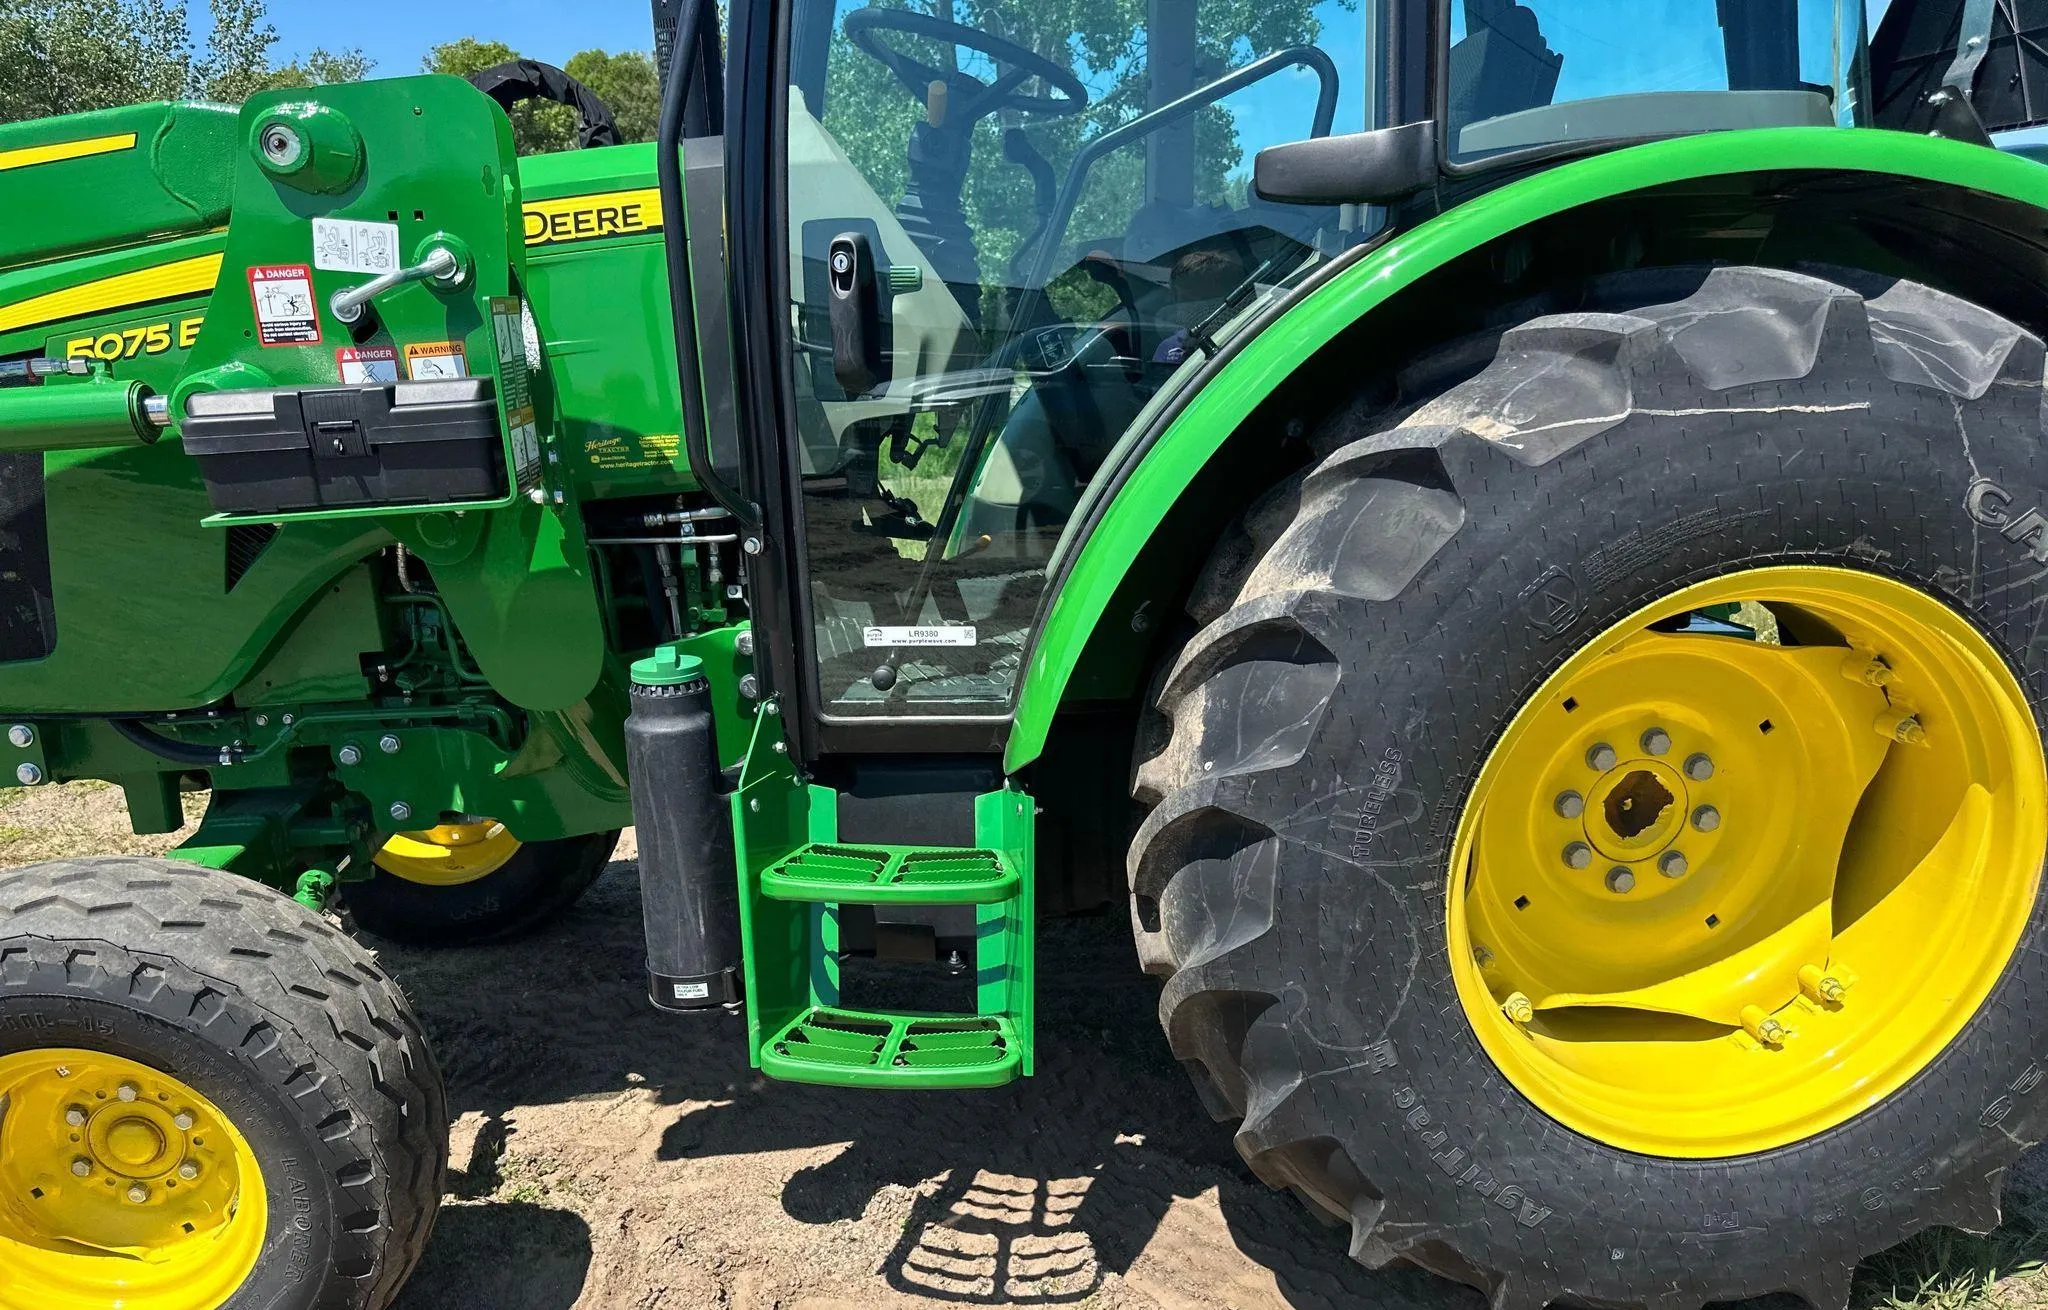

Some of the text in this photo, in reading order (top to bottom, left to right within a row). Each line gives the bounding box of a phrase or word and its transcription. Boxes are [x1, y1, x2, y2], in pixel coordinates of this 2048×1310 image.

[523, 203, 643, 239] DEERE
[266, 269, 305, 278] DANGER
[66, 317, 204, 361] 5075 E
[354, 350, 393, 359] DANGER
[420, 344, 462, 355] WARNING
[585, 437, 622, 452] Heritage
[600, 459, 674, 469] www.heritagetractor.com
[908, 630, 939, 638] LR9380
[1352, 747, 1402, 857] TUBELESS
[1392, 1086, 1554, 1229] AgriTrac
[280, 1157, 312, 1283] LABORER
